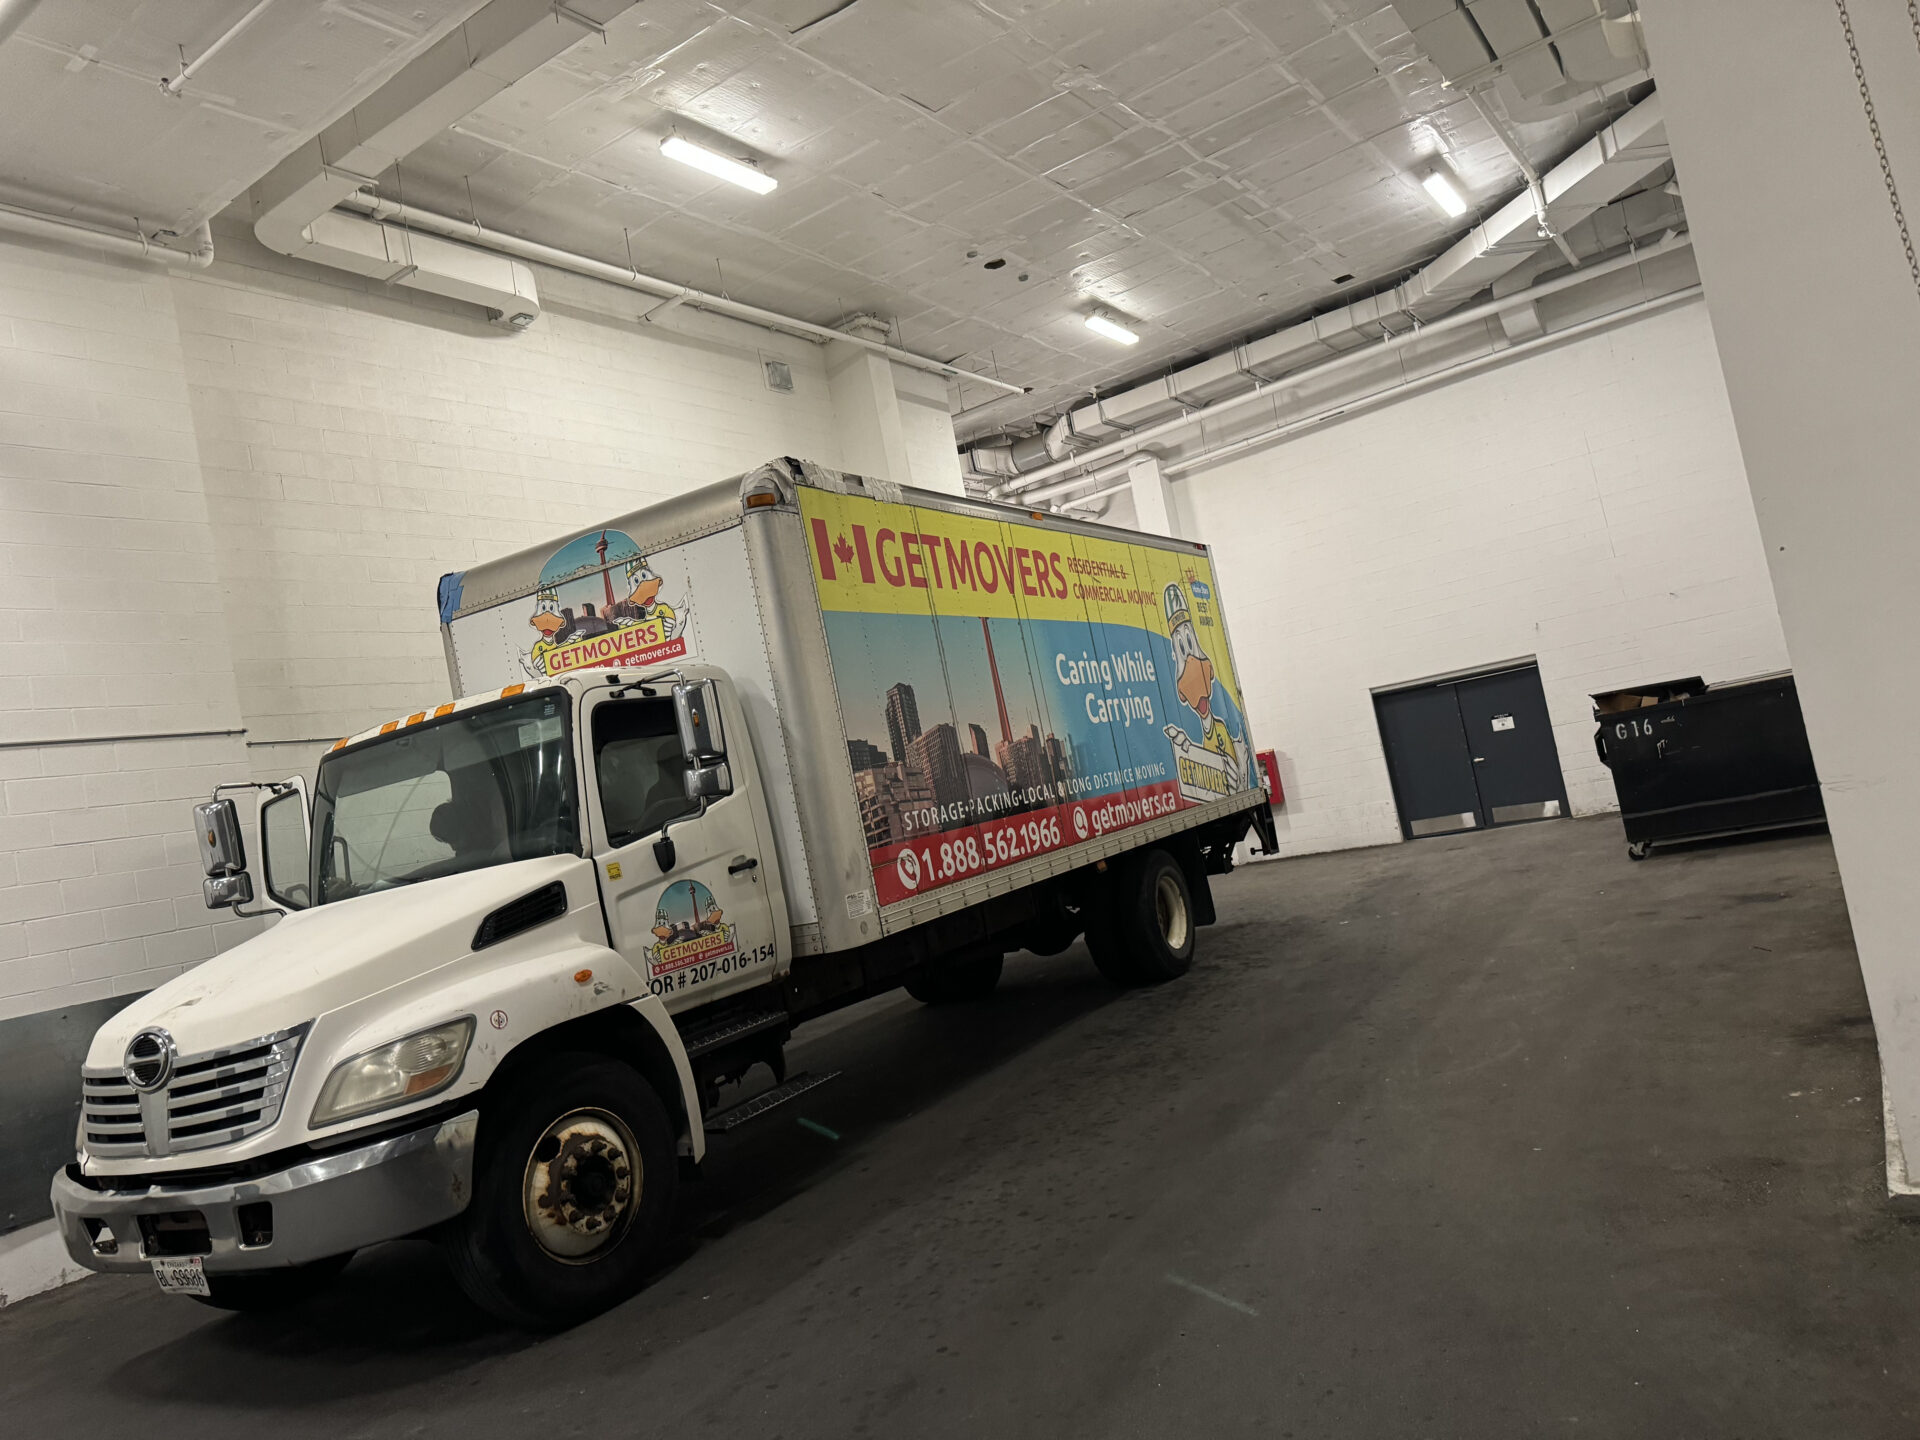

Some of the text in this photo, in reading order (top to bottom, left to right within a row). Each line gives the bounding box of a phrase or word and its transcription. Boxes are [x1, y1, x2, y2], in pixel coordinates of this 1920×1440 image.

[875, 527, 1068, 600] GETMOVERS
[1066, 556, 1127, 580] RESIDENTIAL &
[1073, 582, 1157, 606] COMMERCIAL MOVING
[549, 624, 659, 671] GETMOVERS
[624, 643, 682, 668] getmovers.ca
[1055, 650, 1156, 691] Caring While
[1085, 688, 1154, 728] Carrying
[1057, 781, 1066, 797] &
[1066, 775, 1092, 795] LONG
[1093, 768, 1134, 789] DISTANCE
[1134, 762, 1166, 780] MOVING
[921, 791, 1176, 882] 1.888.562.1966 getmovers.ca
[663, 933, 722, 961] GETMOVERS
[646, 943, 775, 996] OR # 207-016-154
